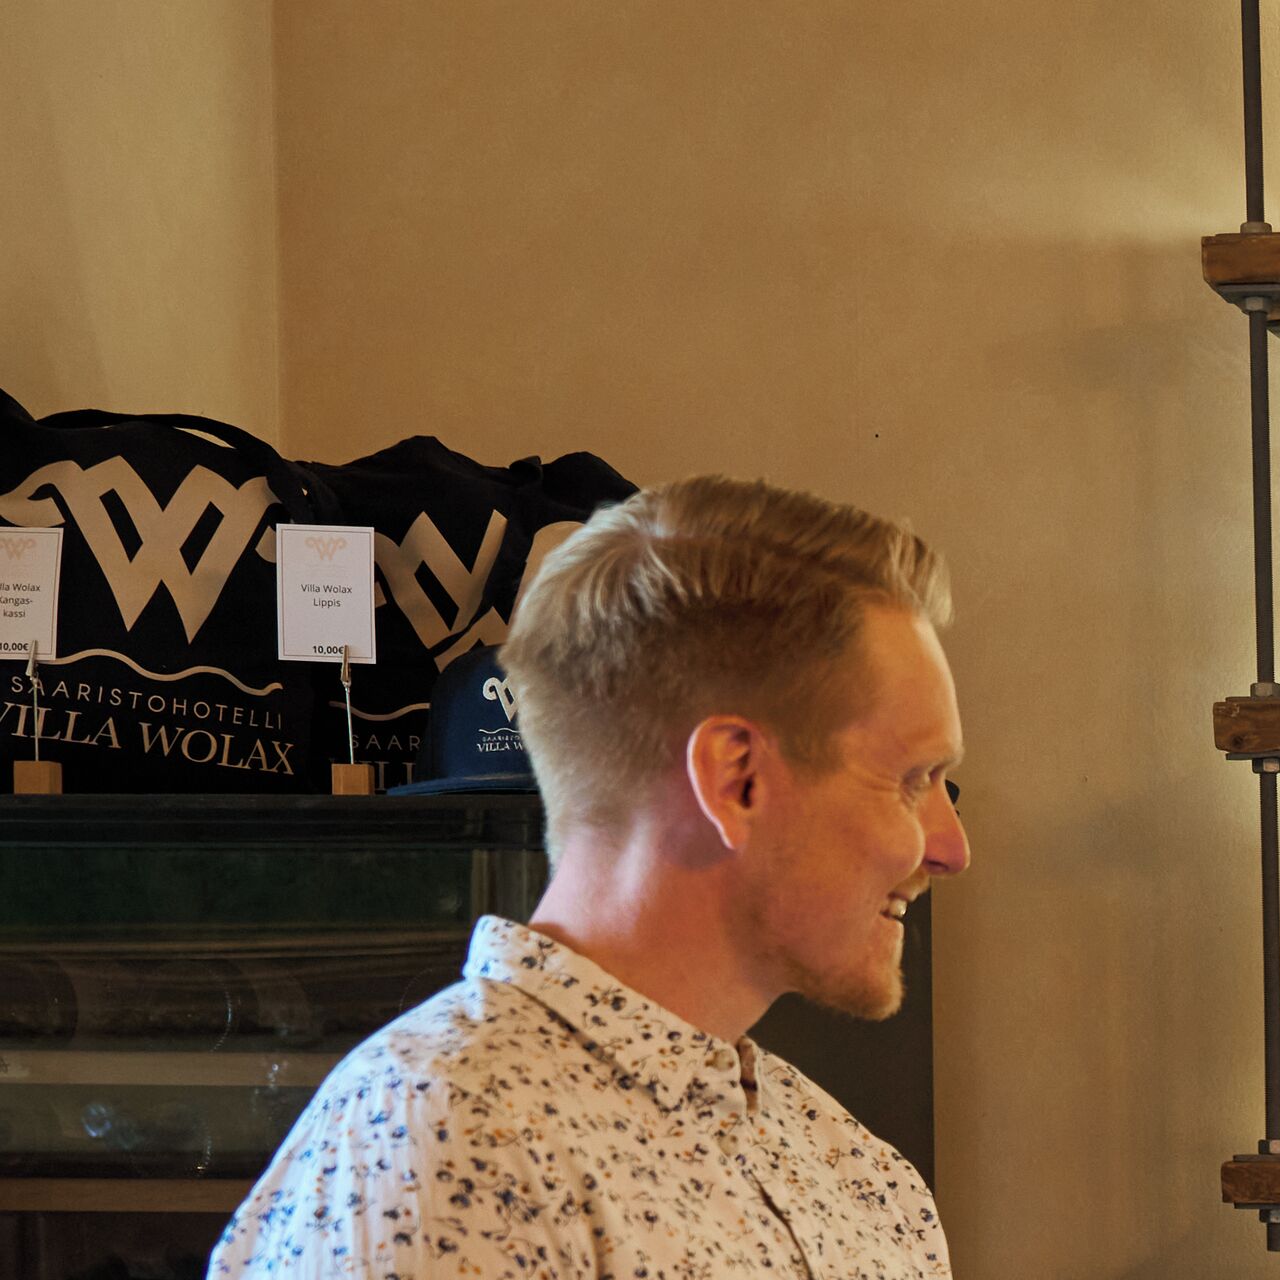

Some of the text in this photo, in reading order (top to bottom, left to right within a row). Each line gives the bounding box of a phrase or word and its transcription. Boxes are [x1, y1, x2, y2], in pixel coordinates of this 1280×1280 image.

[12, 583, 41, 592] Wolax
[301, 583, 352, 594] Villa Wolax
[313, 598, 341, 608] Lippis
[3, 609, 26, 618] kassi
[312, 645, 345, 655] 10,00€
[11, 676, 282, 730] SAARISTOHOTELLI
[138, 721, 294, 775] WOLAX
[477, 742, 510, 752] VILLA
